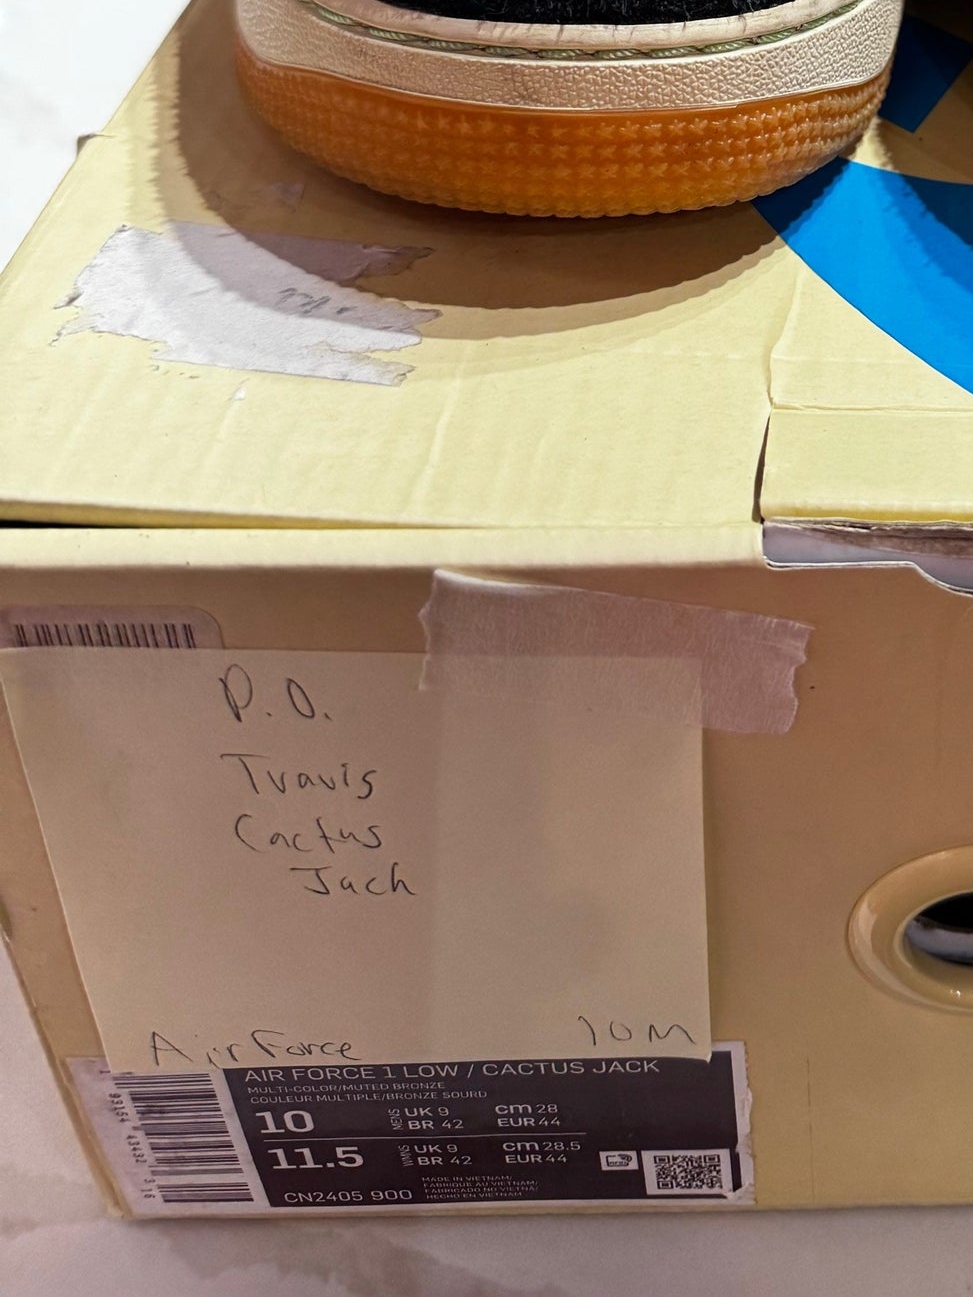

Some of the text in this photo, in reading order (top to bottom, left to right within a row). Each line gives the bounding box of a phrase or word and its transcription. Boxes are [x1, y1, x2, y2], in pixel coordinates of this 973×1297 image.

[235, 813, 382, 854] Cactus
[244, 1060, 661, 1082] AIR FORCE 1 LOW / CACTUS JACK
[247, 1081, 446, 1094] MULTI-COLOR/MUTED BRONZE
[250, 1090, 487, 1104] COULEUR MULTIPLE/BRONZE SOURD
[404, 1104, 558, 1117] UK 9 cm 28
[255, 1110, 315, 1134] 10
[407, 1117, 560, 1130] BR 42 EUR 44
[414, 1141, 581, 1153] UK 9 cm 28.5
[267, 1146, 364, 1170] 11.5
[417, 1153, 568, 1166] BR 42 EUR 44
[284, 1189, 413, 1203] CN2405 900
